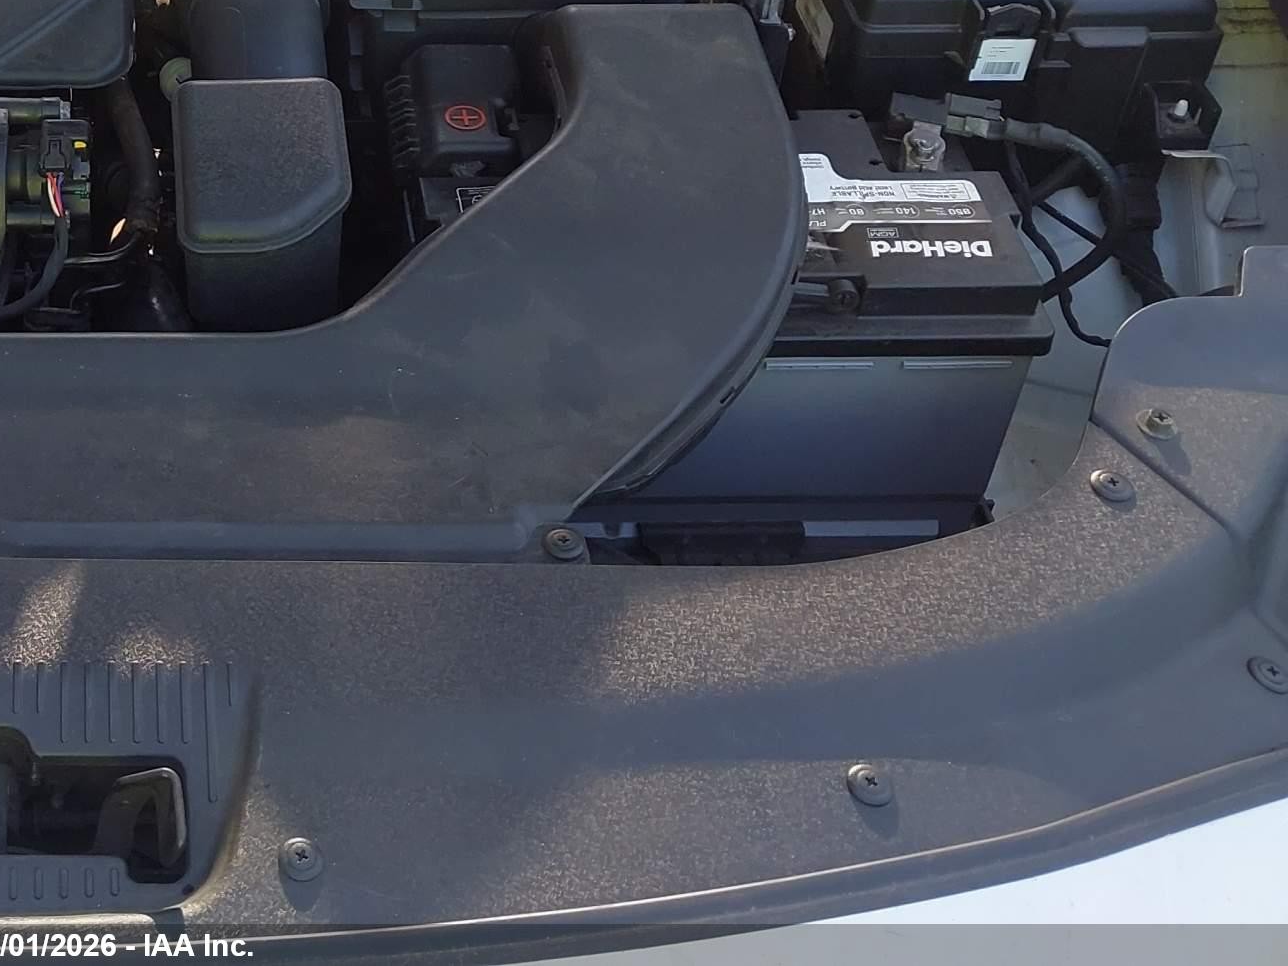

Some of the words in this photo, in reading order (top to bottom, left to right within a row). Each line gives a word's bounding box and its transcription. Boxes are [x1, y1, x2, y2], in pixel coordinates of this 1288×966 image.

[895, 207, 916, 215] 140
[947, 207, 972, 216] 850
[870, 240, 993, 258] DieHard
